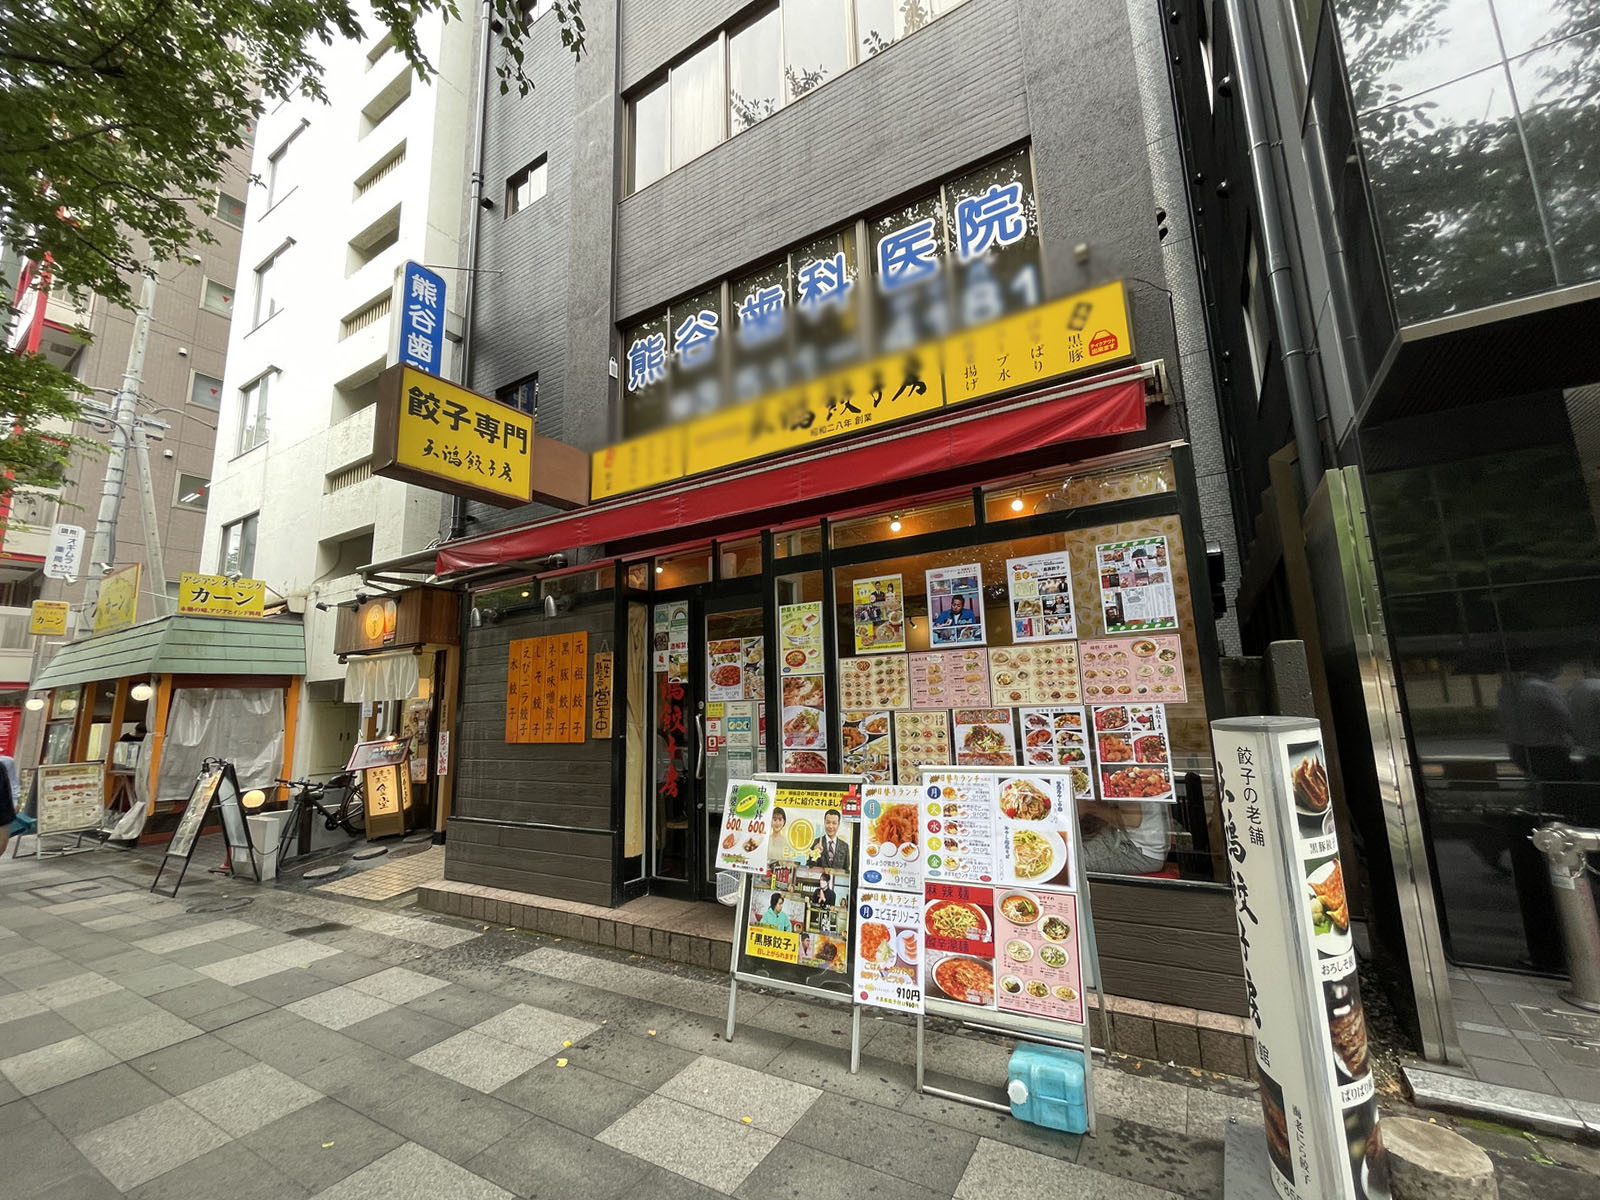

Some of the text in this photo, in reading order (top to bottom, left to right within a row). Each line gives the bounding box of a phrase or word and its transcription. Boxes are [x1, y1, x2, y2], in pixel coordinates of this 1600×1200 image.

[1068, 333, 1084, 364] 黒豚
[408, 386, 528, 455] 餃子専門
[855, 412, 872, 425] 創業
[191, 587, 256, 606] カーン
[36, 616, 63, 625] カーン
[519, 646, 531, 736] えびニラ餃子
[531, 645, 542, 736] しそ餃子
[558, 641, 569, 736] 黒豚餃子
[572, 639, 584, 736] 元祖餃子
[595, 686, 610, 733] 営業中
[754, 785, 767, 820] 中華丼
[1237, 745, 1265, 847] 餃子の老舗
[894, 875, 916, 886] 910円
[873, 893, 918, 905] 日替りランチ
[874, 908, 921, 924] エビ玉チリソース
[749, 931, 797, 952] 「黒豚餃子」
[896, 987, 920, 1002] 910円
